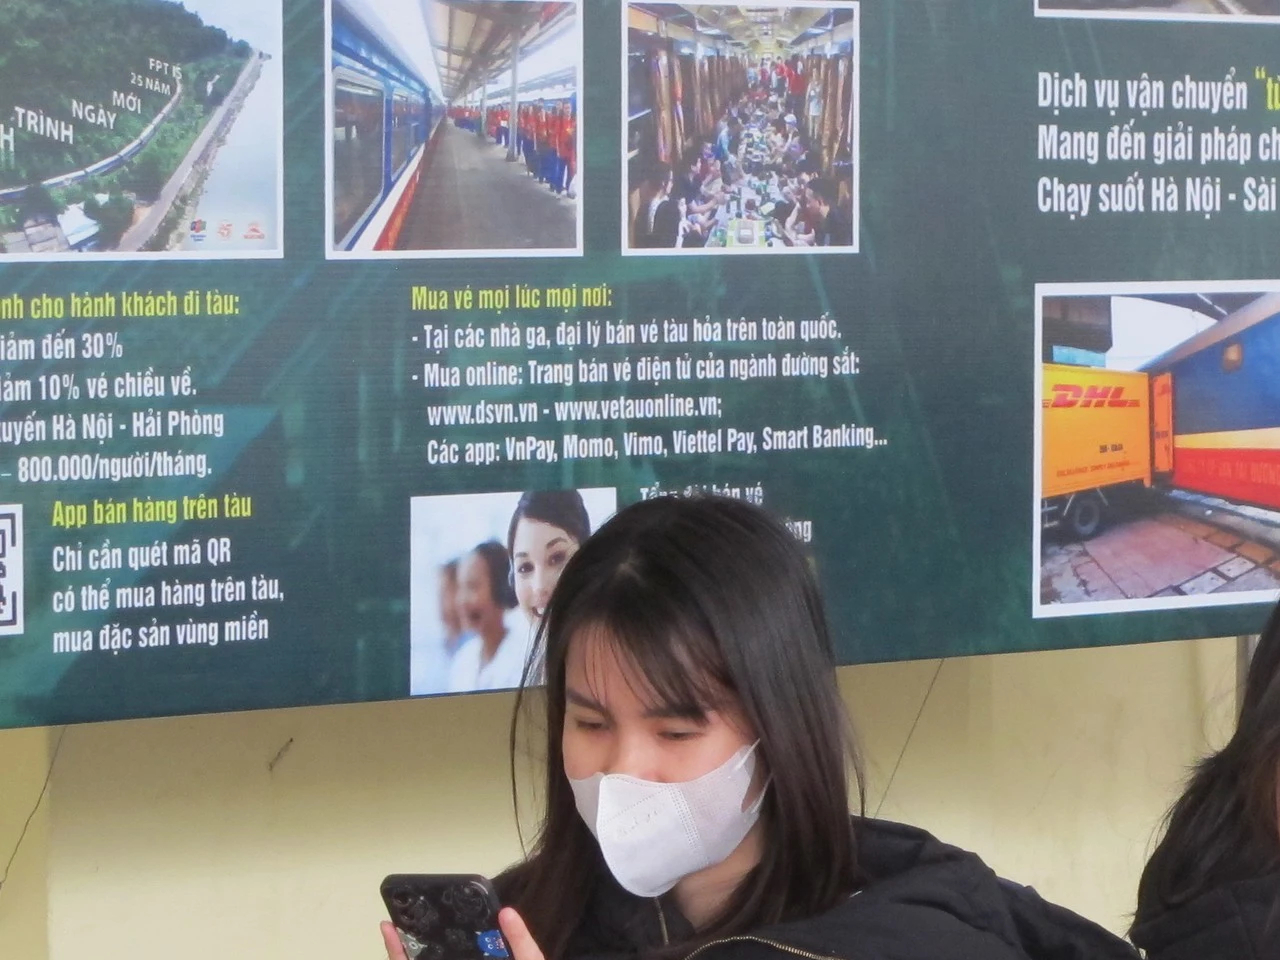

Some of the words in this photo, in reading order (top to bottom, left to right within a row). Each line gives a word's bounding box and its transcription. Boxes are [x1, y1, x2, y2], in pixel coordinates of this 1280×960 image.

[130, 72, 143, 87] 25
[149, 58, 169, 76] FPT
[1038, 71, 1087, 116] Dịch
[1094, 78, 1119, 116] vụ
[1126, 72, 1165, 116] vận
[1171, 66, 1248, 114] chuyển
[14, 106, 74, 145] TRÌNH
[71, 99, 117, 130] NGÀY
[112, 90, 142, 114] MỚI
[1038, 124, 1099, 164] Mang
[1106, 118, 1146, 161] đến
[1153, 121, 1193, 164] giải
[1200, 125, 1251, 165] pháp
[1037, 176, 1092, 220] Chạy
[1098, 171, 1145, 212] suốt
[1151, 176, 1178, 212] Hà
[1185, 176, 1221, 219] Nội
[1243, 176, 1276, 212] Sài
[31, 293, 64, 318] cho
[71, 291, 115, 317] hành
[122, 290, 177, 316] khách
[184, 290, 200, 315] đi
[206, 289, 240, 315] tàu:
[412, 286, 448, 310] Mua
[454, 285, 473, 309] vé
[479, 284, 510, 314] mọi
[515, 284, 541, 308] lúc
[546, 284, 577, 313] mọi
[582, 283, 612, 307] nơi:
[42, 328, 75, 359] đến
[82, 332, 123, 358] 30%
[424, 324, 449, 354] Tại
[455, 323, 485, 348] các
[490, 322, 521, 347] nhà
[526, 325, 551, 349] ga,
[556, 321, 581, 351] đại
[587, 320, 601, 348] lý
[606, 319, 635, 344] bán
[640, 318, 658, 343] vé
[663, 318, 688, 343] tàu
[693, 315, 722, 342] hỏa
[727, 316, 757, 341] trên
[762, 316, 795, 340] toàn
[800, 312, 842, 342] quốc.
[39, 374, 80, 400] 10%
[87, 372, 108, 399] vé
[114, 367, 164, 398] chiều
[171, 366, 196, 395] về.
[424, 363, 460, 388] Mua
[466, 362, 523, 386] online:
[528, 360, 573, 386] Trang
[578, 358, 608, 383] bán
[613, 357, 631, 382] vé
[637, 356, 671, 386] điện
[676, 352, 691, 380] tử
[696, 352, 725, 379] của
[730, 353, 777, 380] ngành
[782, 353, 828, 378] đường
[833, 346, 860, 375] sắt:
[427, 400, 538, 426] www.dsvn.vn
[555, 394, 722, 421] www.vetauonline.vn;
[1052, 384, 1127, 408] DHL
[0, 410, 46, 445] uyến
[52, 413, 76, 440] Hà
[82, 412, 113, 444] Nội
[132, 409, 162, 437] Hải
[168, 409, 224, 438] Phòng
[427, 439, 459, 465] Các
[465, 441, 500, 466] app:
[505, 436, 558, 463] VnPay,
[563, 434, 618, 460] Momo,
[623, 432, 667, 457] Vimo,
[673, 429, 722, 454] Viettel
[727, 428, 757, 454] Pay,
[762, 426, 808, 450] Smart
[18, 450, 212, 482] 800.000/người/tháng.
[52, 501, 87, 529] App
[93, 497, 127, 525] bán
[133, 496, 177, 524] hàng
[183, 493, 218, 520] trên
[224, 492, 252, 518] tàu
[745, 481, 764, 506] vé
[52, 541, 82, 572] Chỉ
[88, 538, 122, 570] cần
[128, 540, 168, 571] quét
[174, 538, 201, 565] mã
[207, 537, 231, 566] QR
[53, 585, 75, 613] có
[81, 577, 111, 611] thể
[116, 586, 155, 609] mua
[161, 579, 205, 607] hàng
[211, 576, 246, 603] trên
[251, 574, 284, 602] tàu,
[53, 629, 93, 653] mua
[99, 622, 132, 655] đặc
[138, 617, 170, 647] sản
[176, 618, 219, 646] vùng
[224, 610, 269, 642] miền
